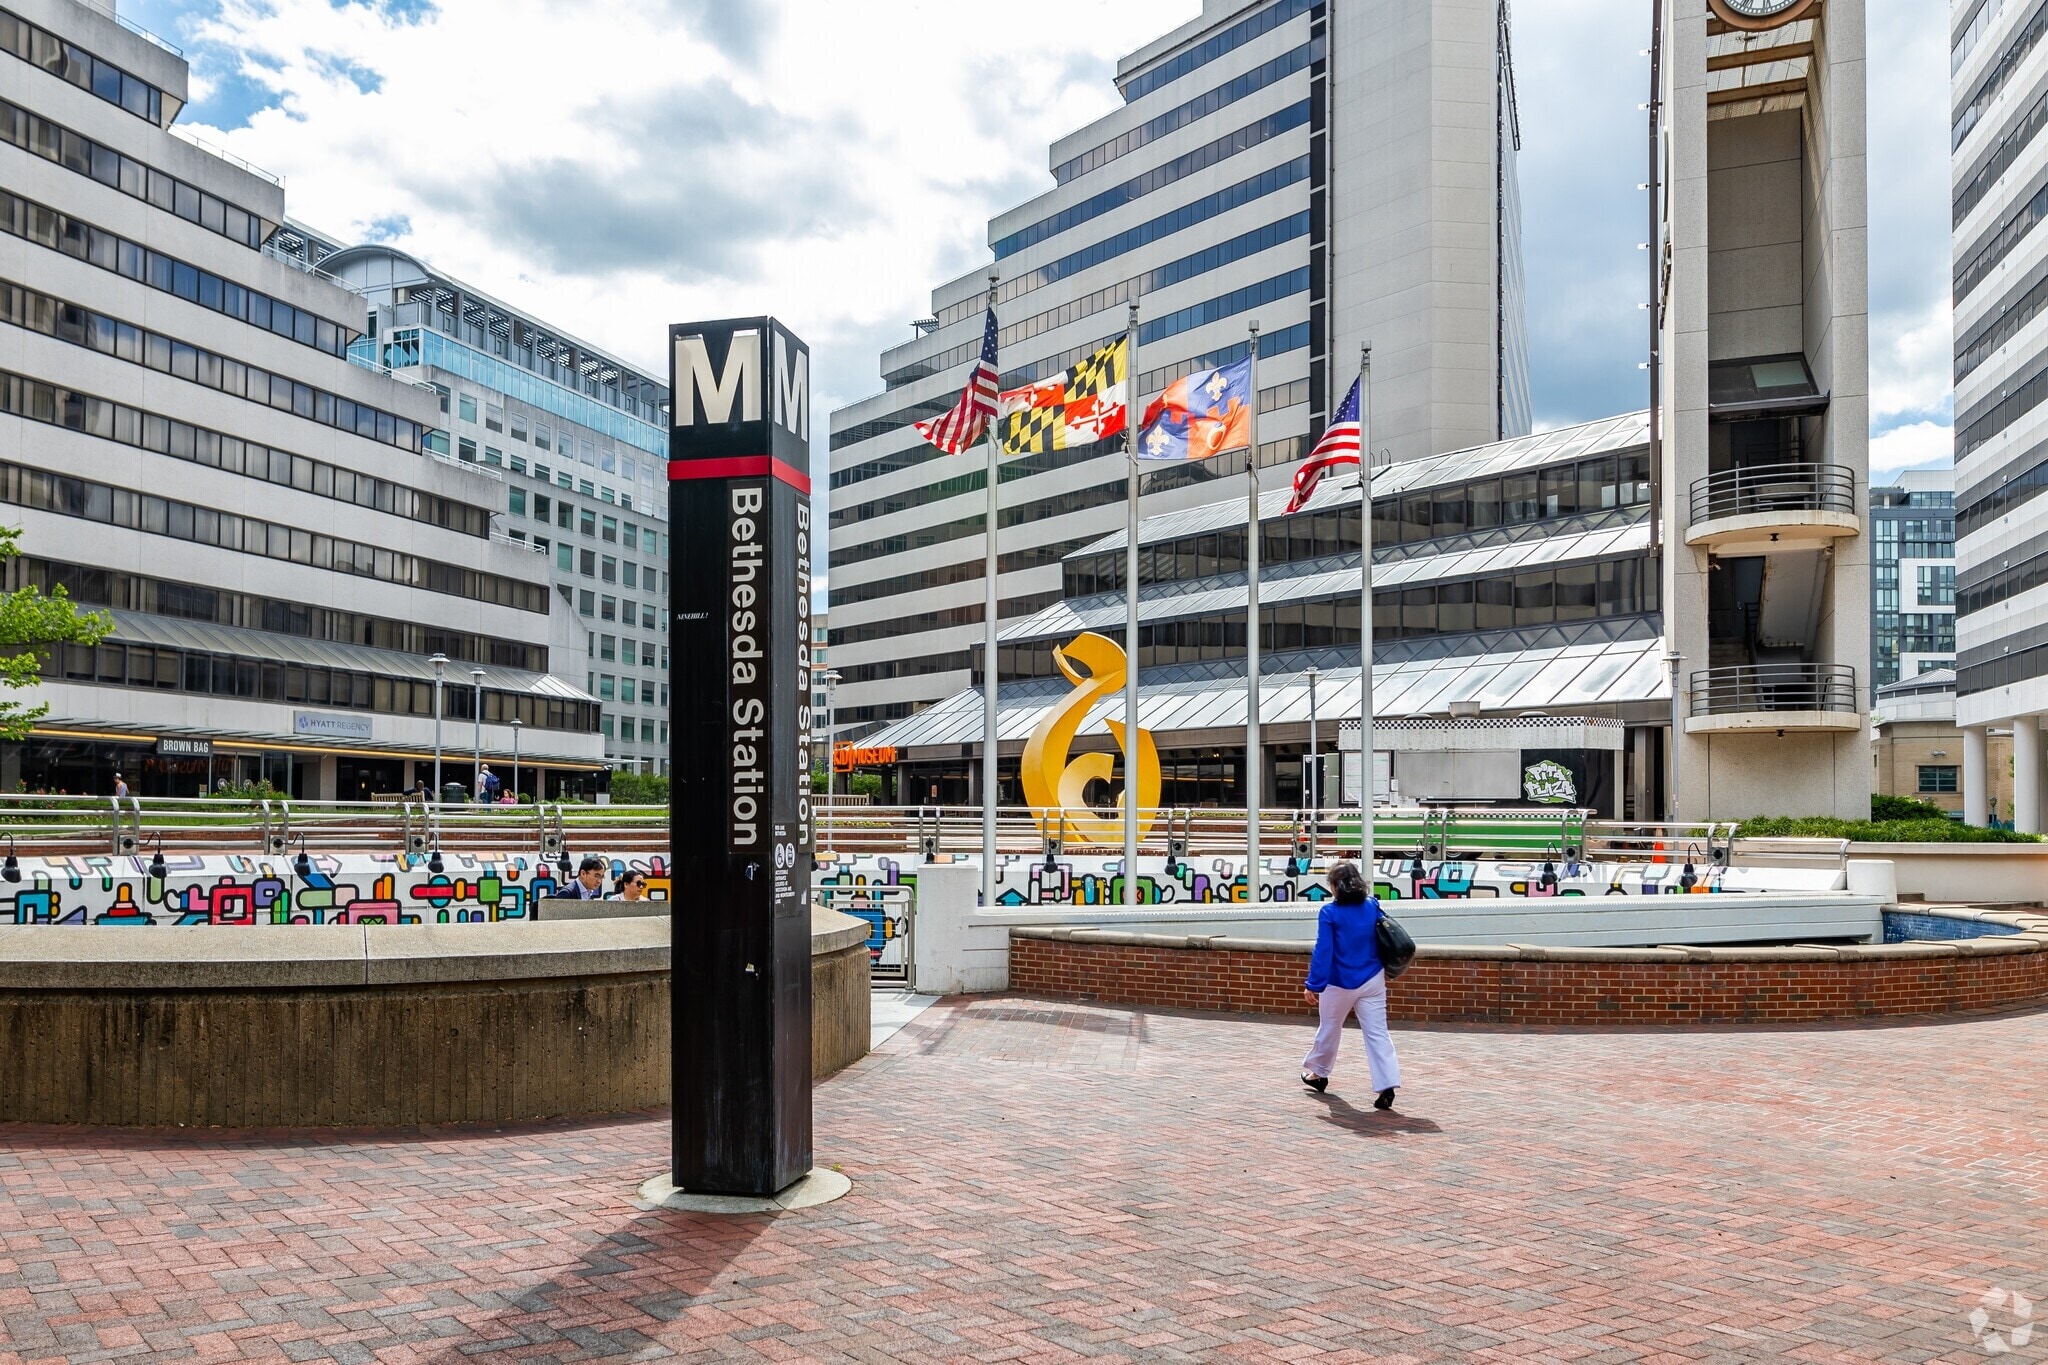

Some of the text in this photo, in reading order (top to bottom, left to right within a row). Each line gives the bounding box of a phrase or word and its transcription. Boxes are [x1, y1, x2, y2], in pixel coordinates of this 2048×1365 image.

[675, 328, 761, 427] M
[775, 330, 807, 442] M
[732, 488, 764, 845] Bethesda Station
[797, 502, 810, 845] Bethesda Station
[163, 739, 209, 753] BROWN BAG
[310, 719, 370, 731] HYATT REGENCY
[852, 746, 895, 765] MUSEUM
[1525, 780, 1575, 798] PLAZA
